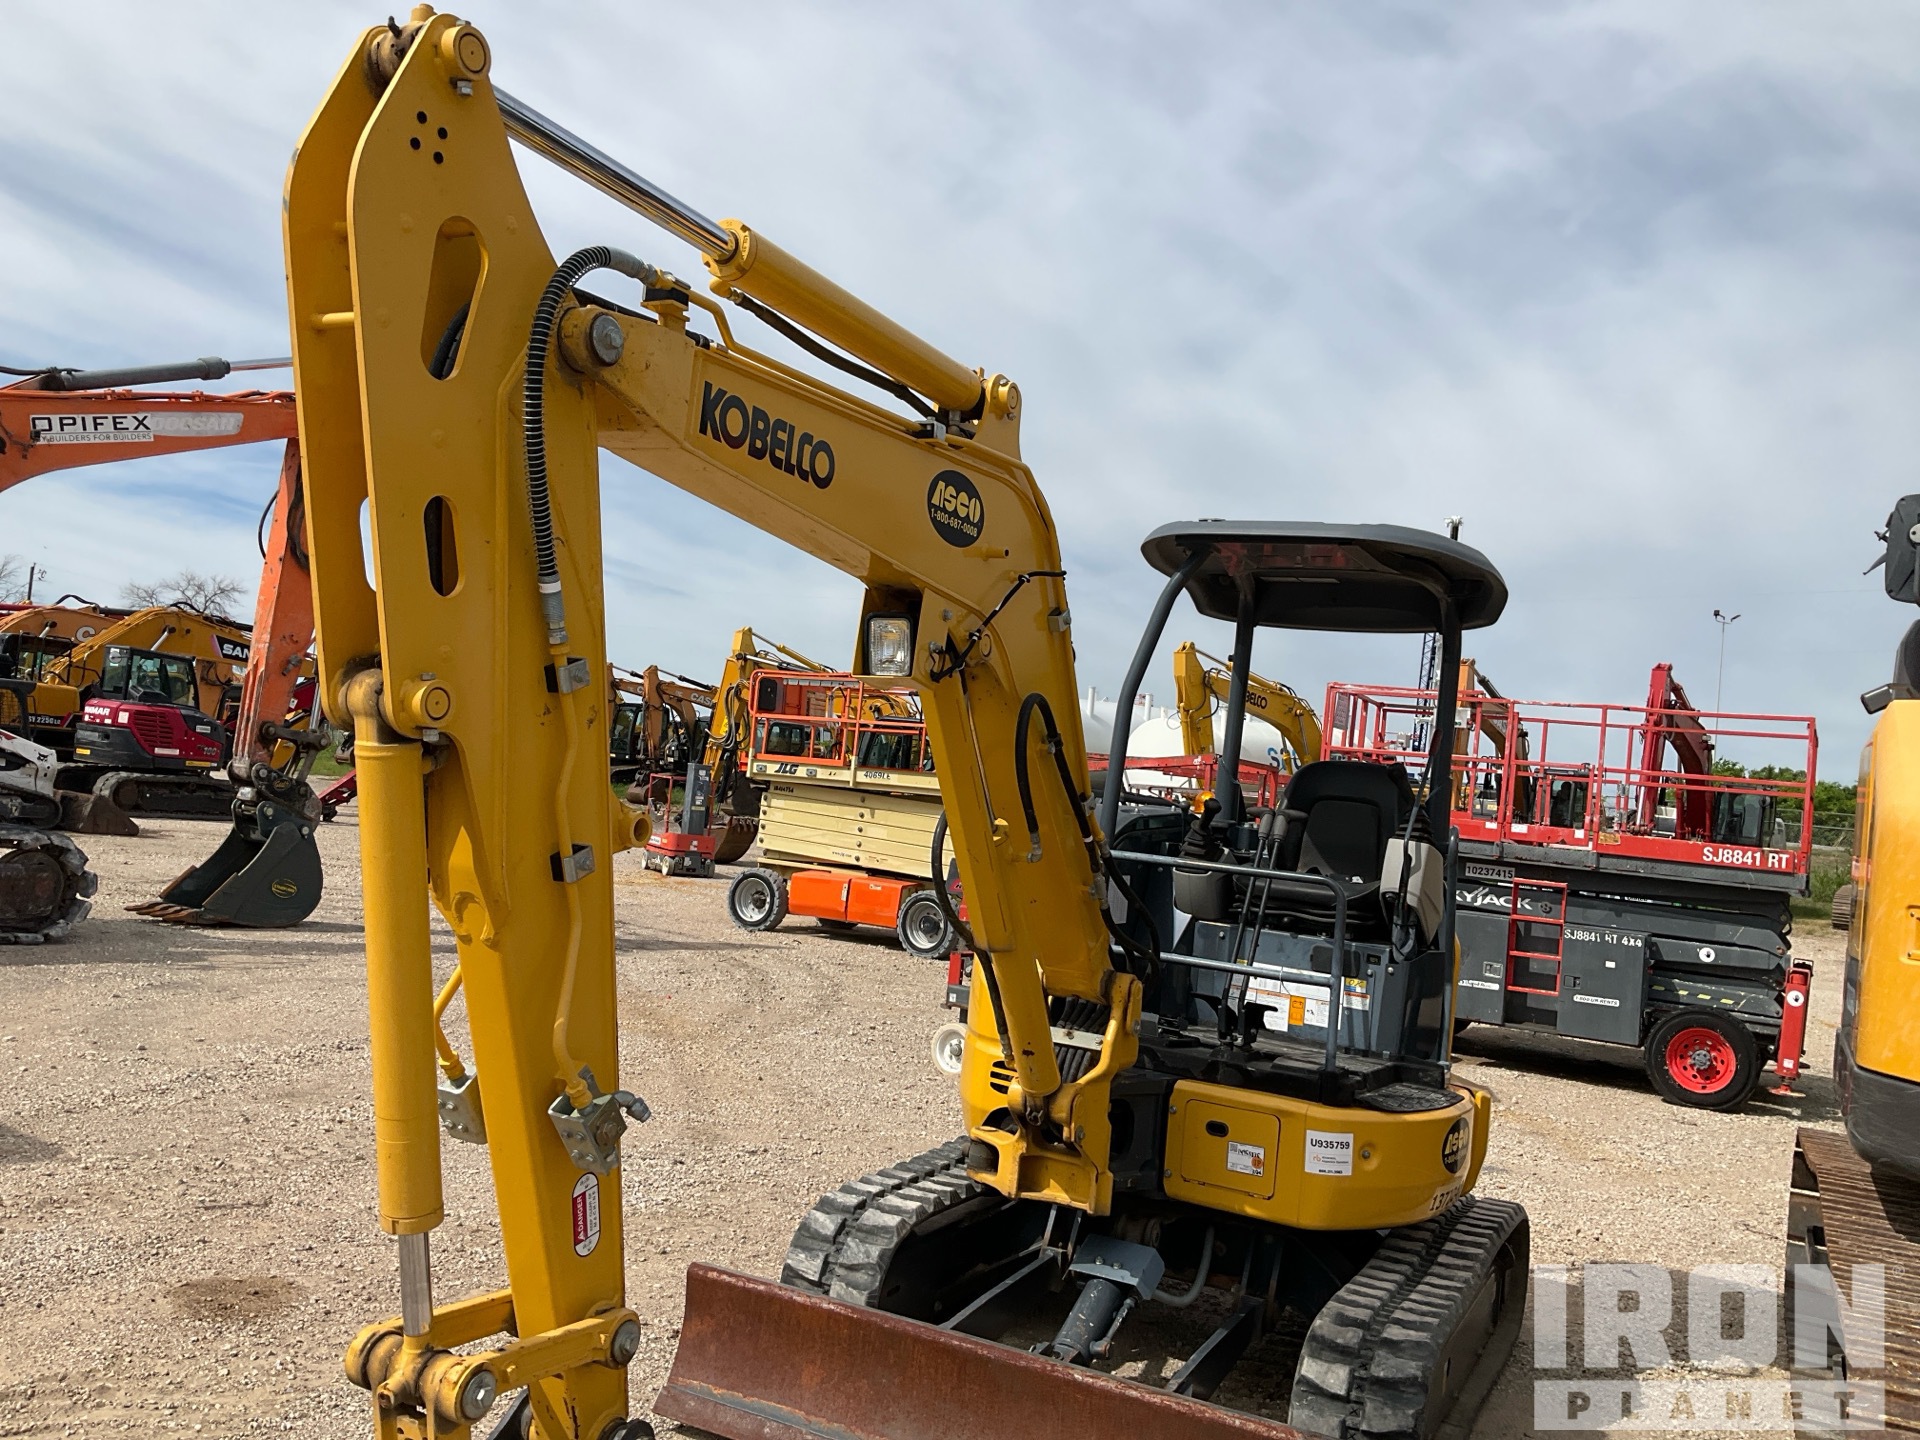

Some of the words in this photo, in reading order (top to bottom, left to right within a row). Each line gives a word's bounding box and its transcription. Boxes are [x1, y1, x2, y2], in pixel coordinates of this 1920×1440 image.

[31, 415, 151, 432] OPIFEX
[50, 434, 91, 442] BUILDERS
[113, 433, 152, 441] BUILDERS
[699, 380, 835, 490] KOBELCO
[931, 480, 981, 524] ASCO
[931, 508, 978, 537] 1-800-687-0008
[222, 643, 250, 659] SAN
[774, 762, 800, 775] JLG
[1702, 847, 1761, 867] SJ8841
[1768, 853, 1790, 869] RT
[1466, 865, 1514, 879] 10237415
[1564, 929, 1601, 943] SJ8841
[1605, 932, 1617, 945] RT
[1310, 1138, 1350, 1149] U935759
